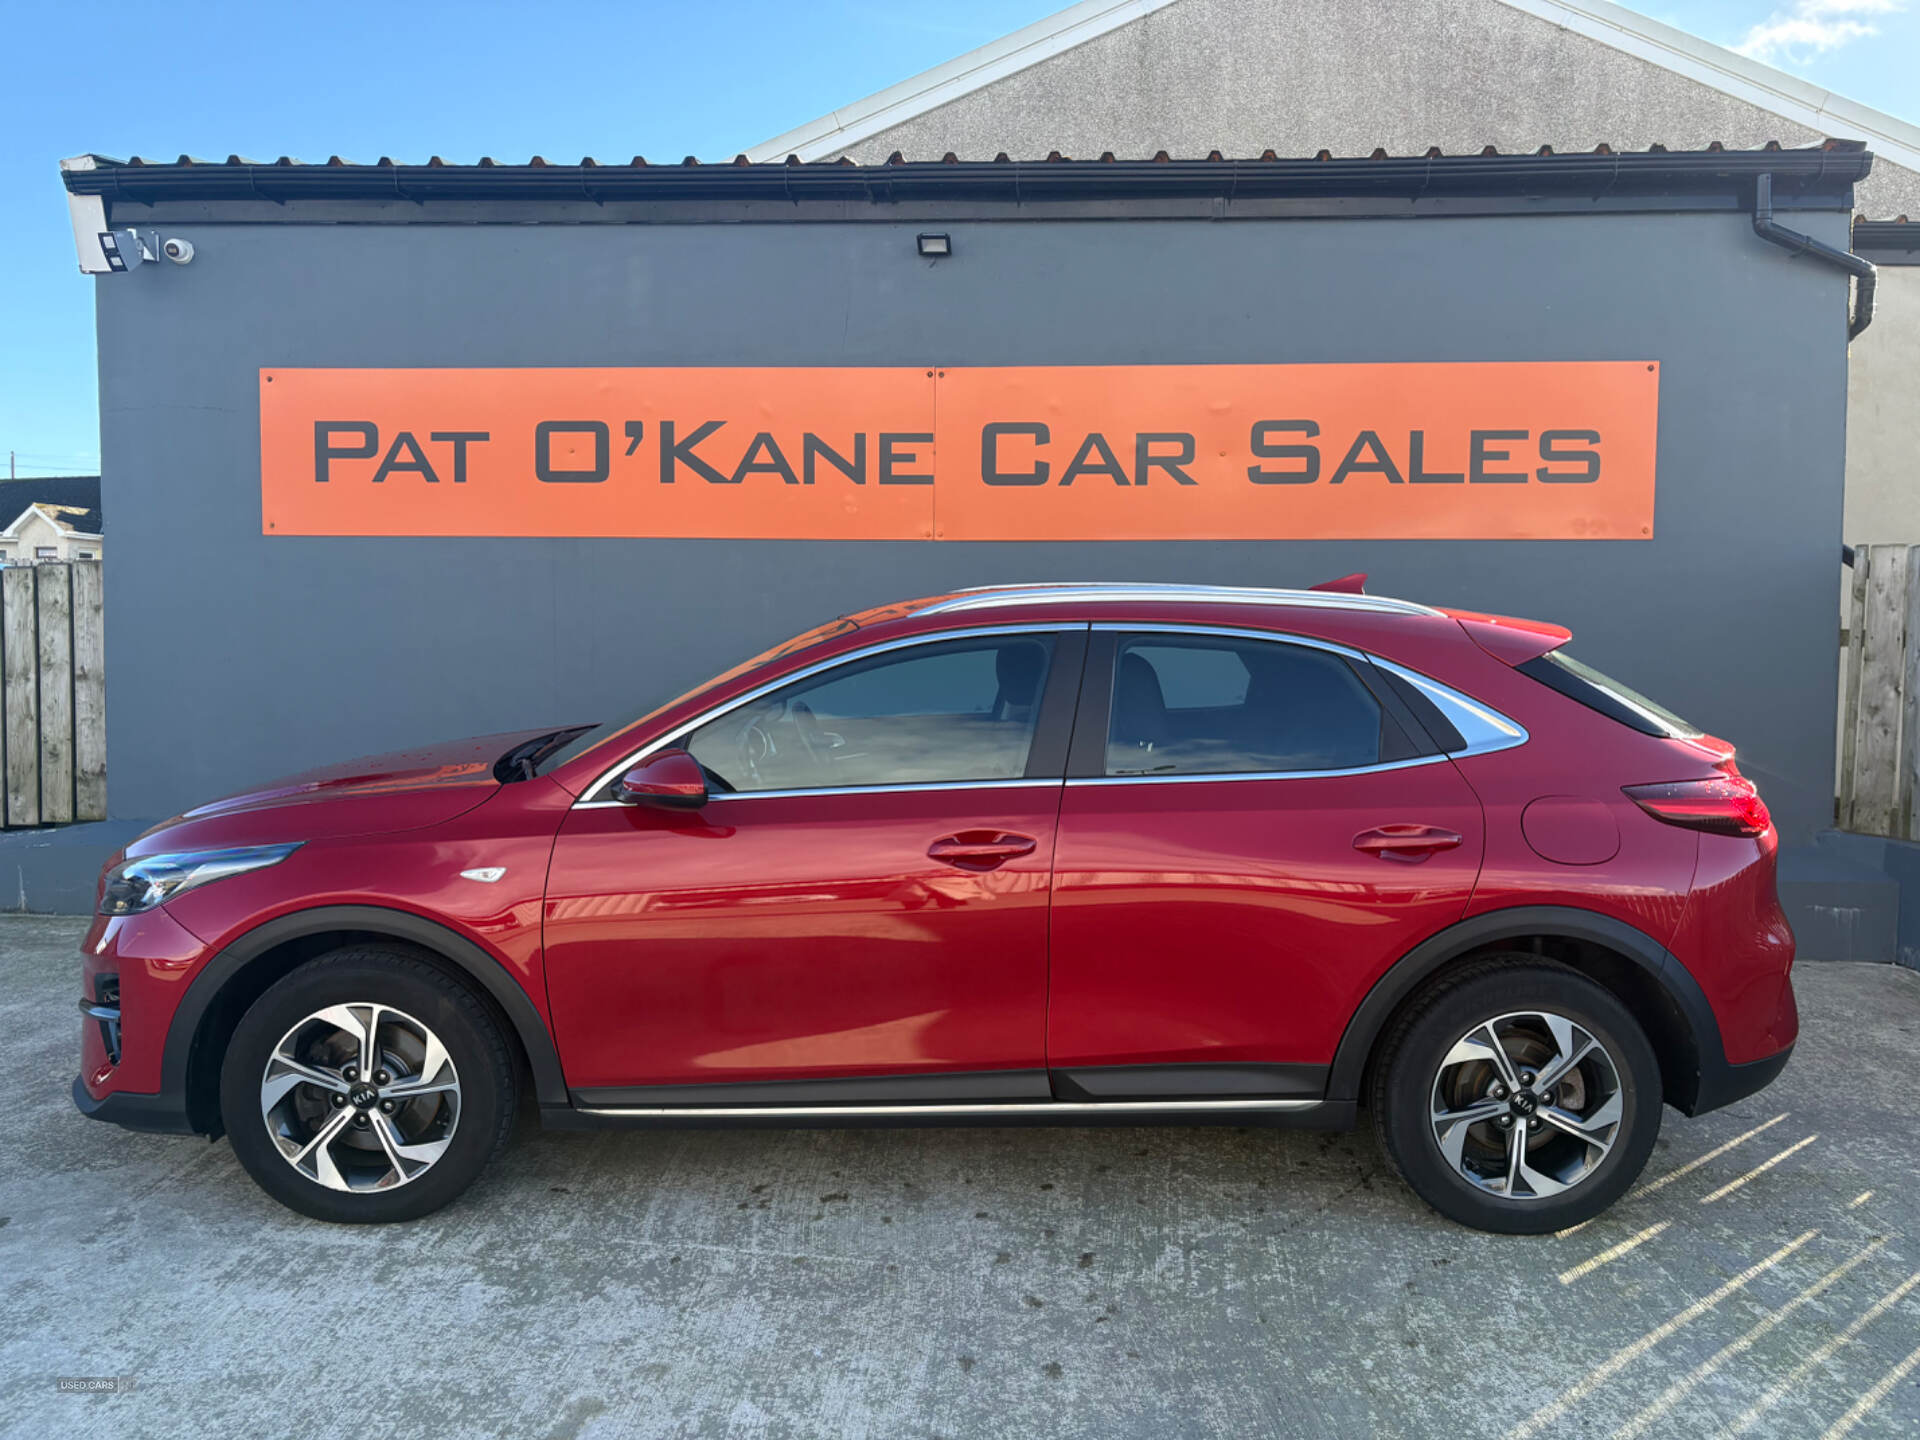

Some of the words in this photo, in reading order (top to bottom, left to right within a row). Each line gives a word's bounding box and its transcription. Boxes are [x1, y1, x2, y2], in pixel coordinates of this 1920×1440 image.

[314, 420, 490, 483] PAT
[535, 420, 935, 485] O'KANE
[981, 422, 1199, 487] CAR
[1247, 419, 1601, 485] SALES
[353, 1090, 375, 1105] KIA
[1514, 1094, 1533, 1112] KIA
